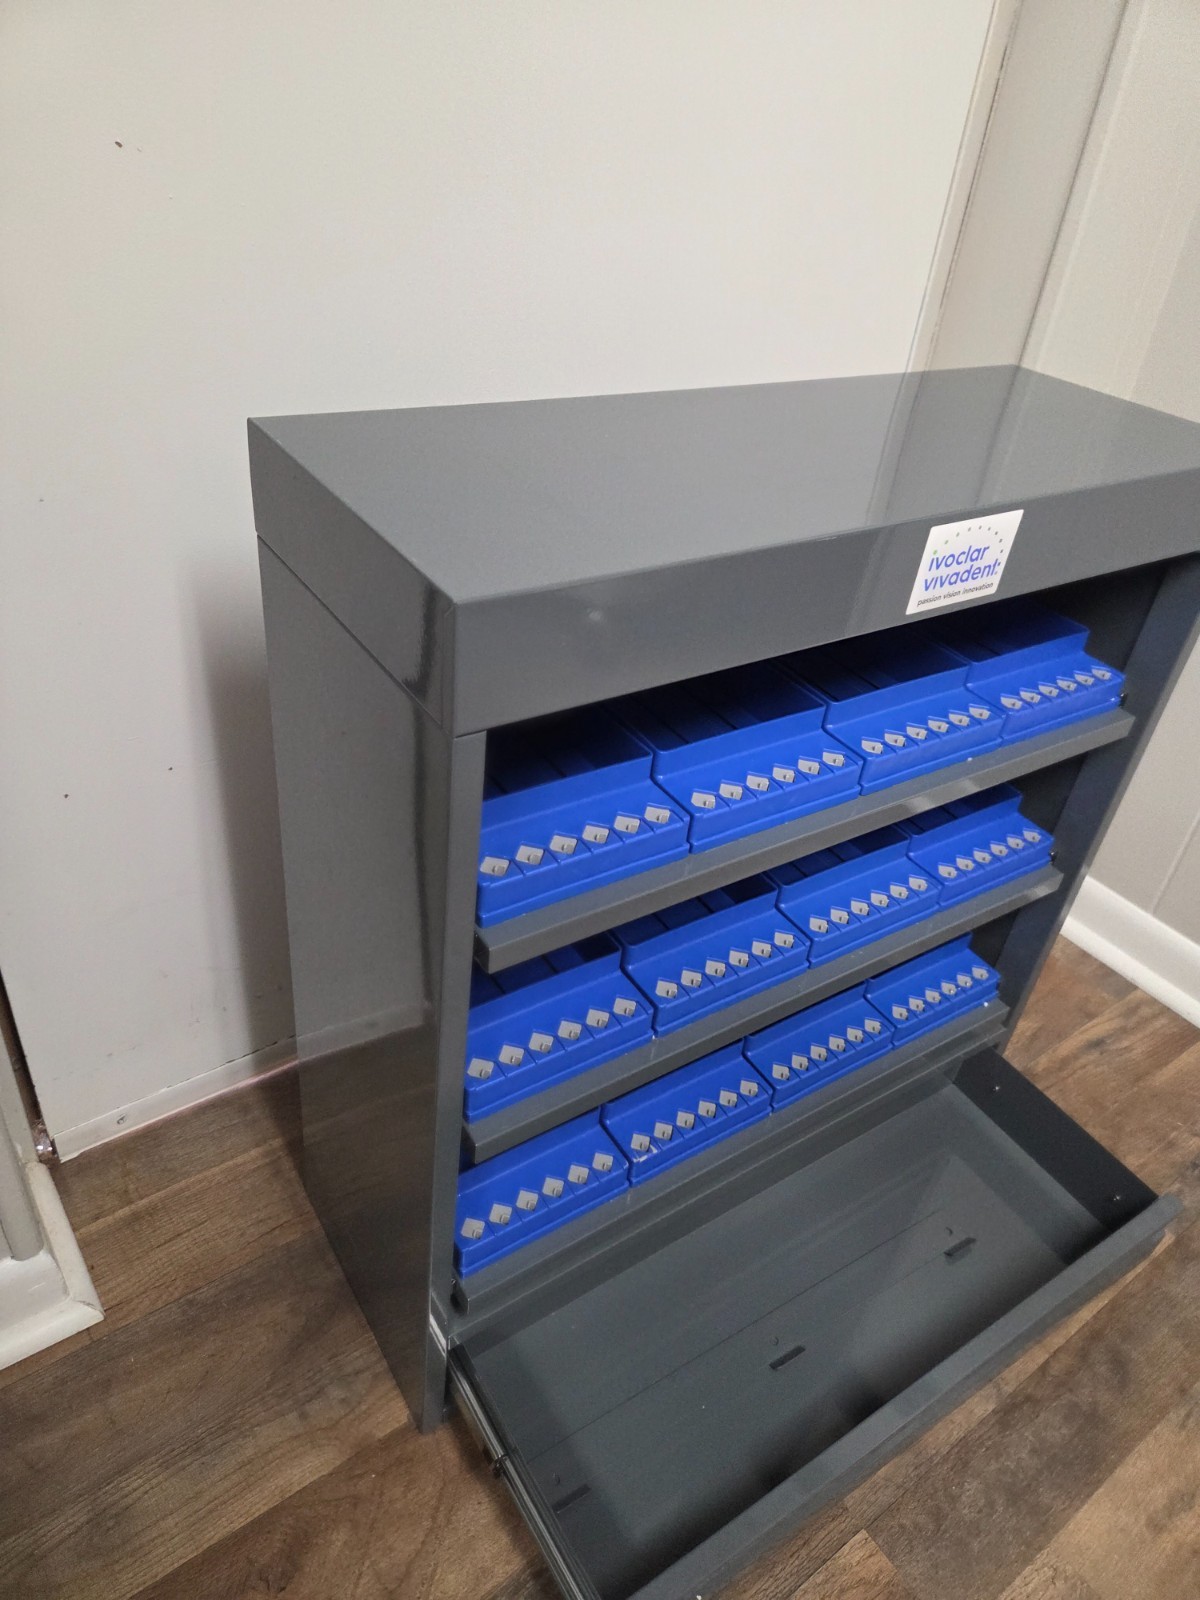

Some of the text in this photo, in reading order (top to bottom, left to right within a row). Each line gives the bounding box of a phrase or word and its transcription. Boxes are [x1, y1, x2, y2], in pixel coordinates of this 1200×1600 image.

[917, 582, 994, 607] passion vision innovation
